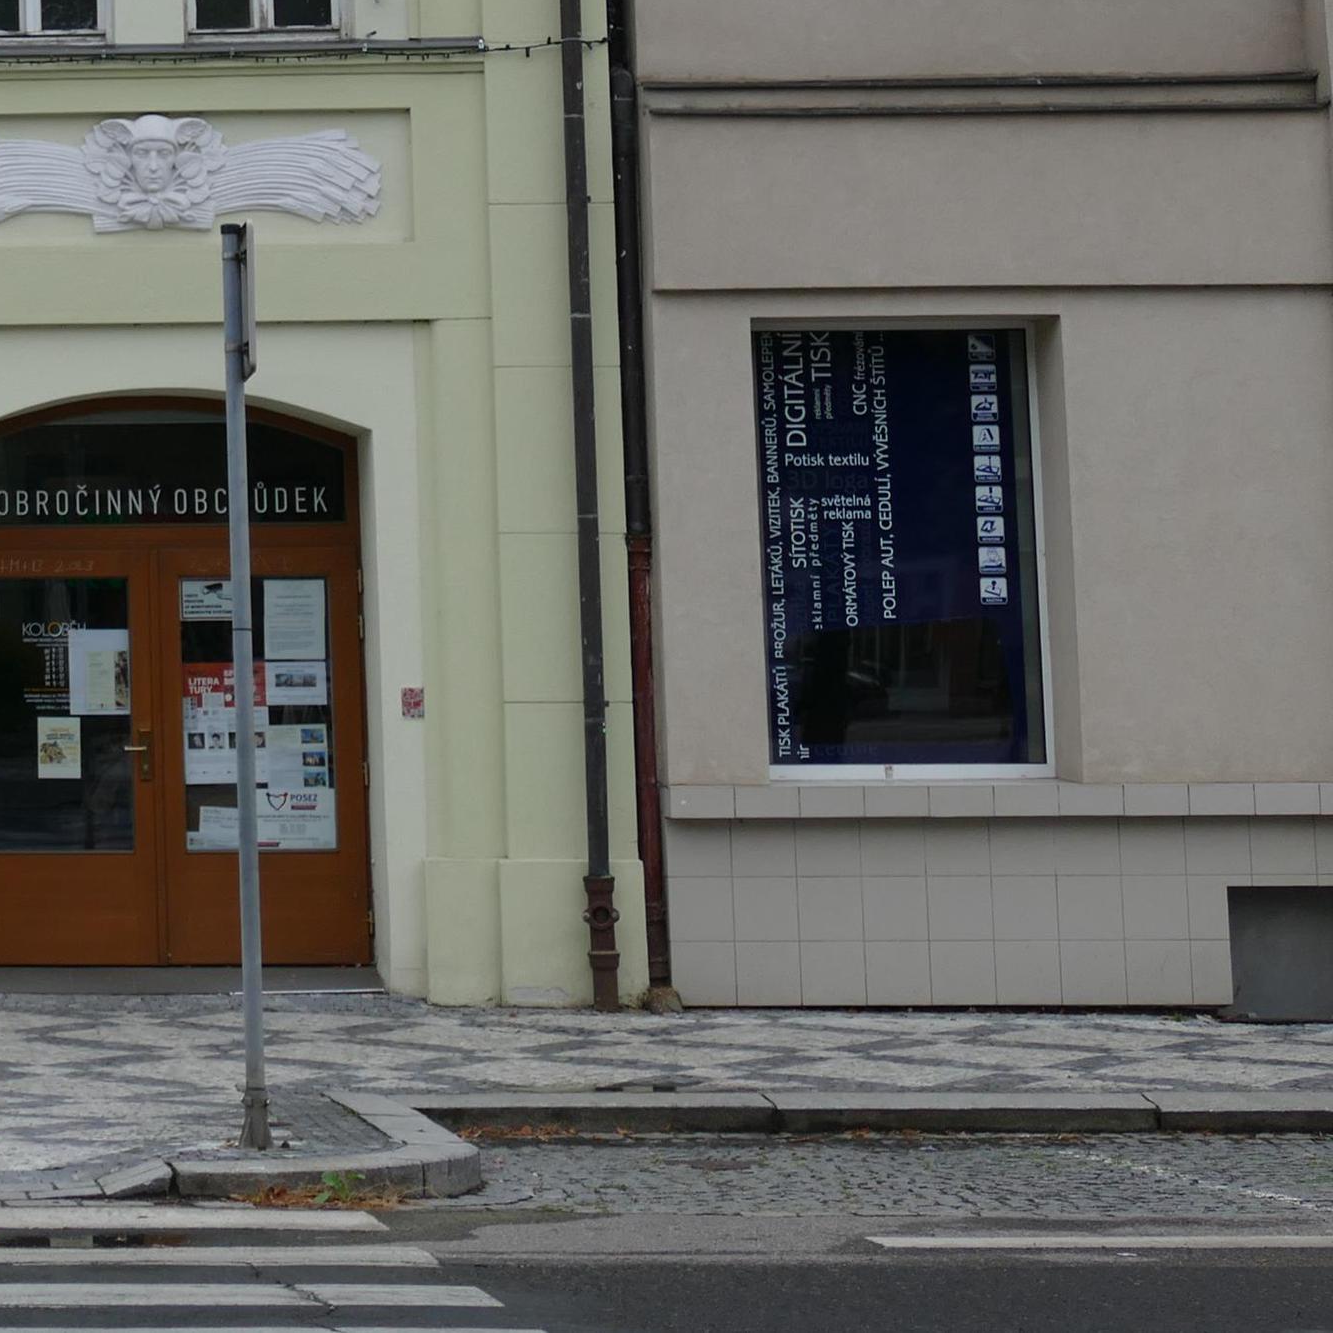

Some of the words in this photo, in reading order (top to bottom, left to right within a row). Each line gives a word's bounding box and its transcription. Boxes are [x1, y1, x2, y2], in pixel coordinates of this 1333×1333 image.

[809, 331, 833, 382] TISK
[869, 345, 886, 386] ŠTÍTŮ
[777, 331, 808, 448] DIGITÁLNÍ
[852, 383, 868, 416] CNC
[761, 413, 779, 483] BANNERŮ,
[871, 389, 890, 471] VÝVĚSNÍCH
[784, 453, 825, 467] Potisk
[828, 452, 870, 466] textilu
[174, 481, 329, 514] OBCŮDEK
[766, 486, 782, 538] VIZITEK,
[820, 494, 871, 507] světelná
[823, 508, 872, 520] reklama
[873, 473, 893, 531] CEDULÍ,
[789, 496, 807, 569] SÍTOTISK
[807, 498, 822, 567] předměty
[841, 521, 854, 550] TISK
[879, 533, 896, 568] AUT,
[766, 541, 786, 595] LETÁKŮ,
[880, 571, 897, 619] POLEP
[776, 729, 792, 757] TISK
